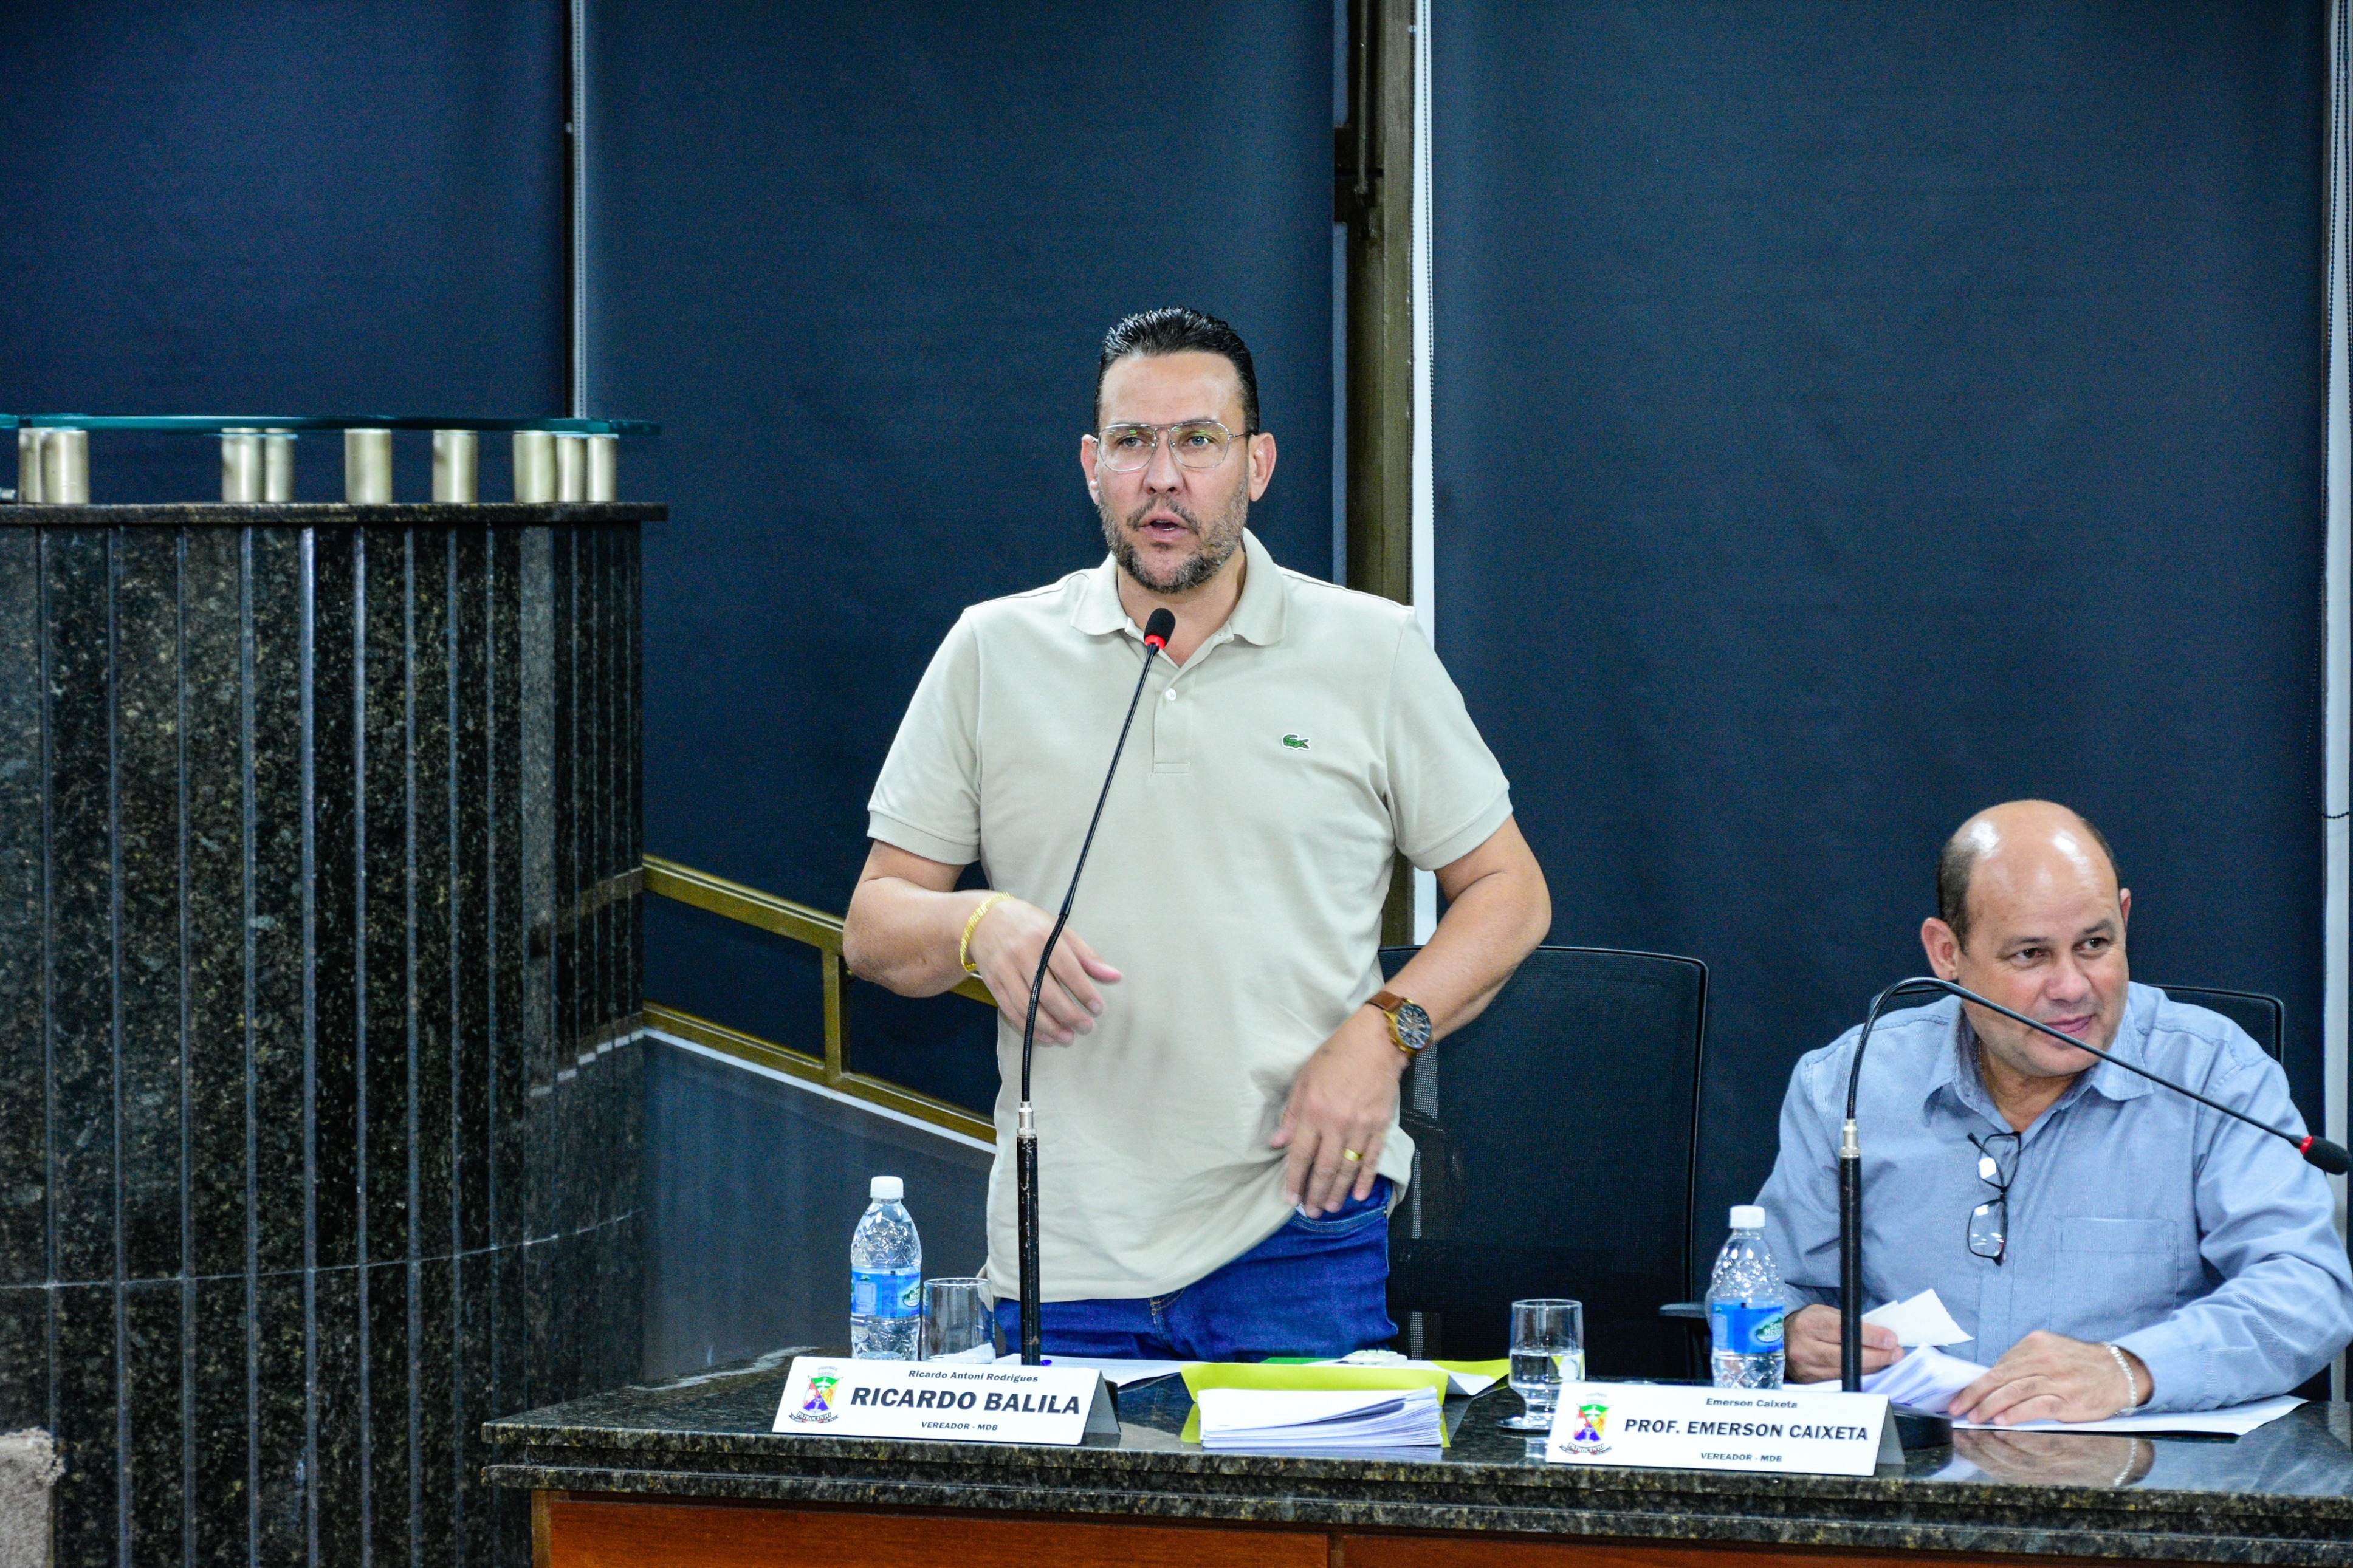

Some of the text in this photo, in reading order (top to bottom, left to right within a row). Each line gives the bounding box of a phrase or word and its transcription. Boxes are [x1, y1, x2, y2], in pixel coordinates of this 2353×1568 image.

[909, 1370, 1039, 1383] Ricardo Antoni Rodrigues
[850, 1387, 1080, 1414] RICARDO BALILA
[1706, 1397, 1798, 1408] Emerson Caixeta
[1624, 1419, 1867, 1440] PROF. EMERSON CAIXETA
